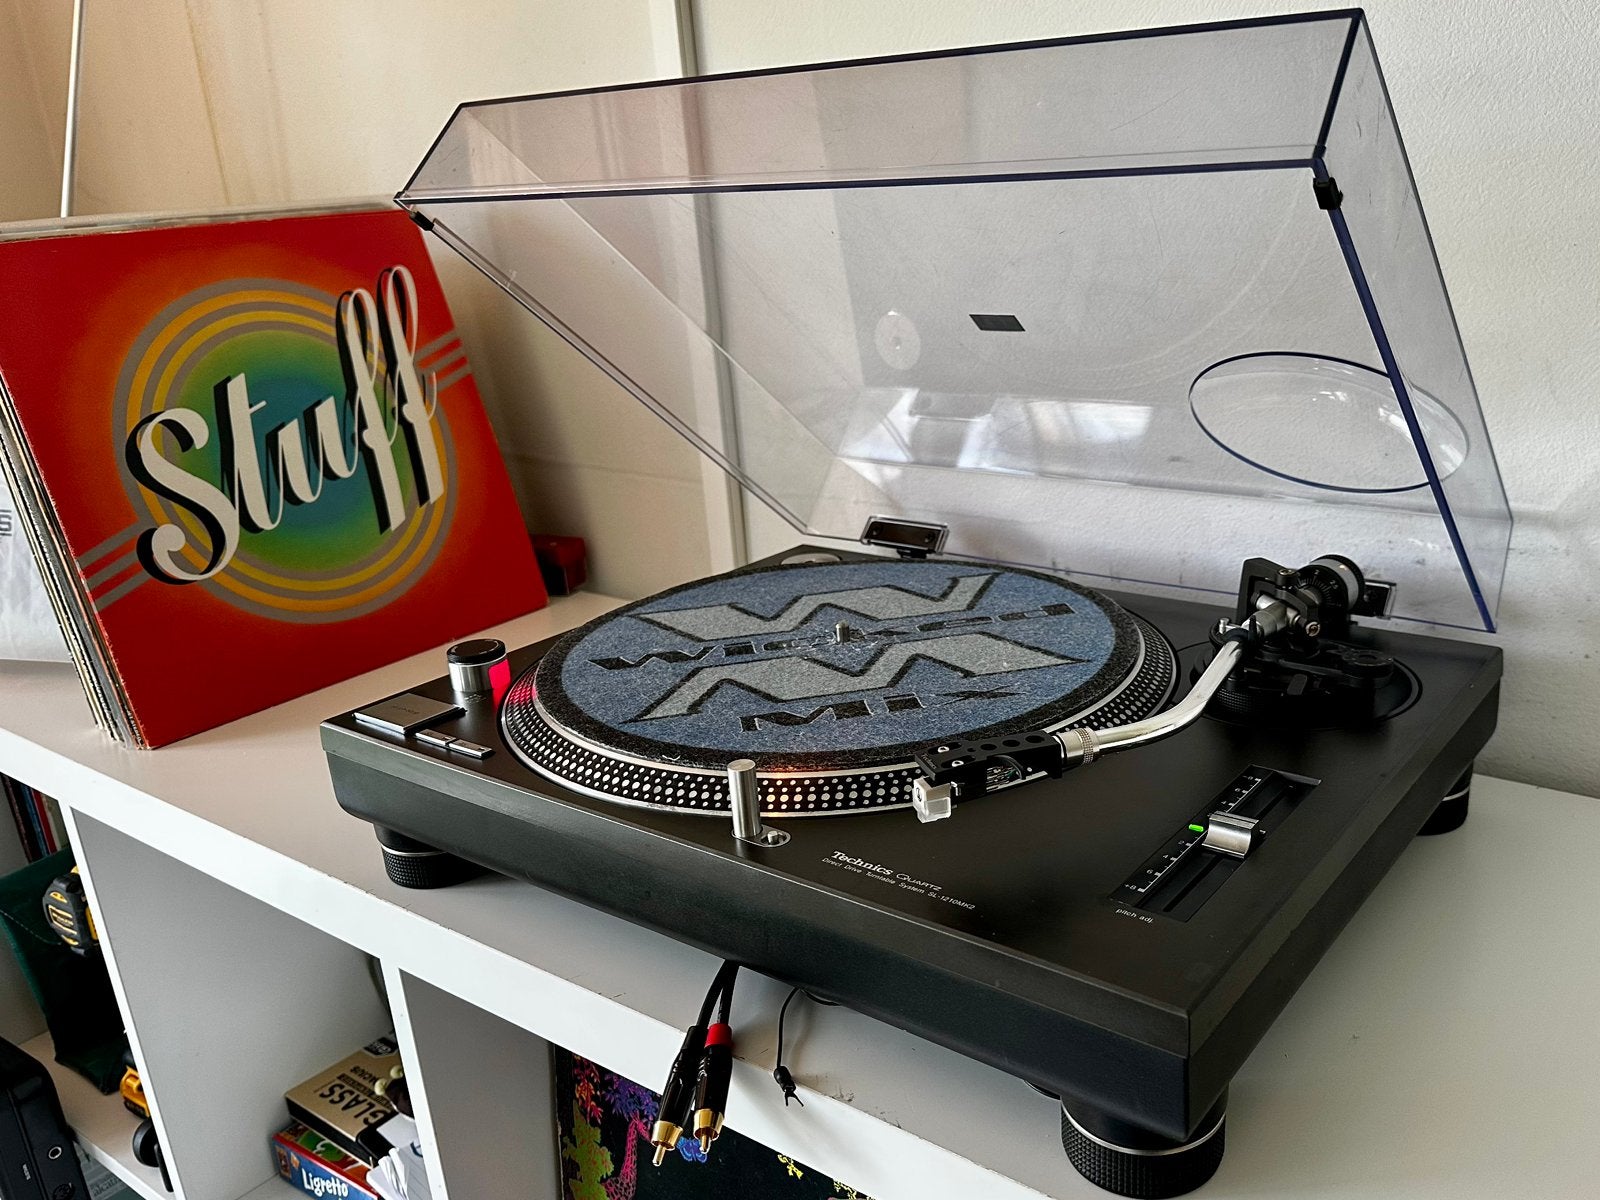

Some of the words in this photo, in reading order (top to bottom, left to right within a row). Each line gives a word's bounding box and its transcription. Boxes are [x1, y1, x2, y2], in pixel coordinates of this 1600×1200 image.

[126, 264, 444, 584] Stuff
[831, 850, 894, 876] Technics
[821, 857, 843, 868] Direct
[844, 864, 863, 874] Drive
[865, 871, 896, 885] Turntable
[898, 882, 925, 894] System
[927, 891, 976, 910] SL-1210MK2
[1115, 907, 1137, 918] pitch
[1138, 913, 1154, 924] adj
[319, 1082, 388, 1127] GLASS
[301, 1167, 349, 1198] Ligretto
